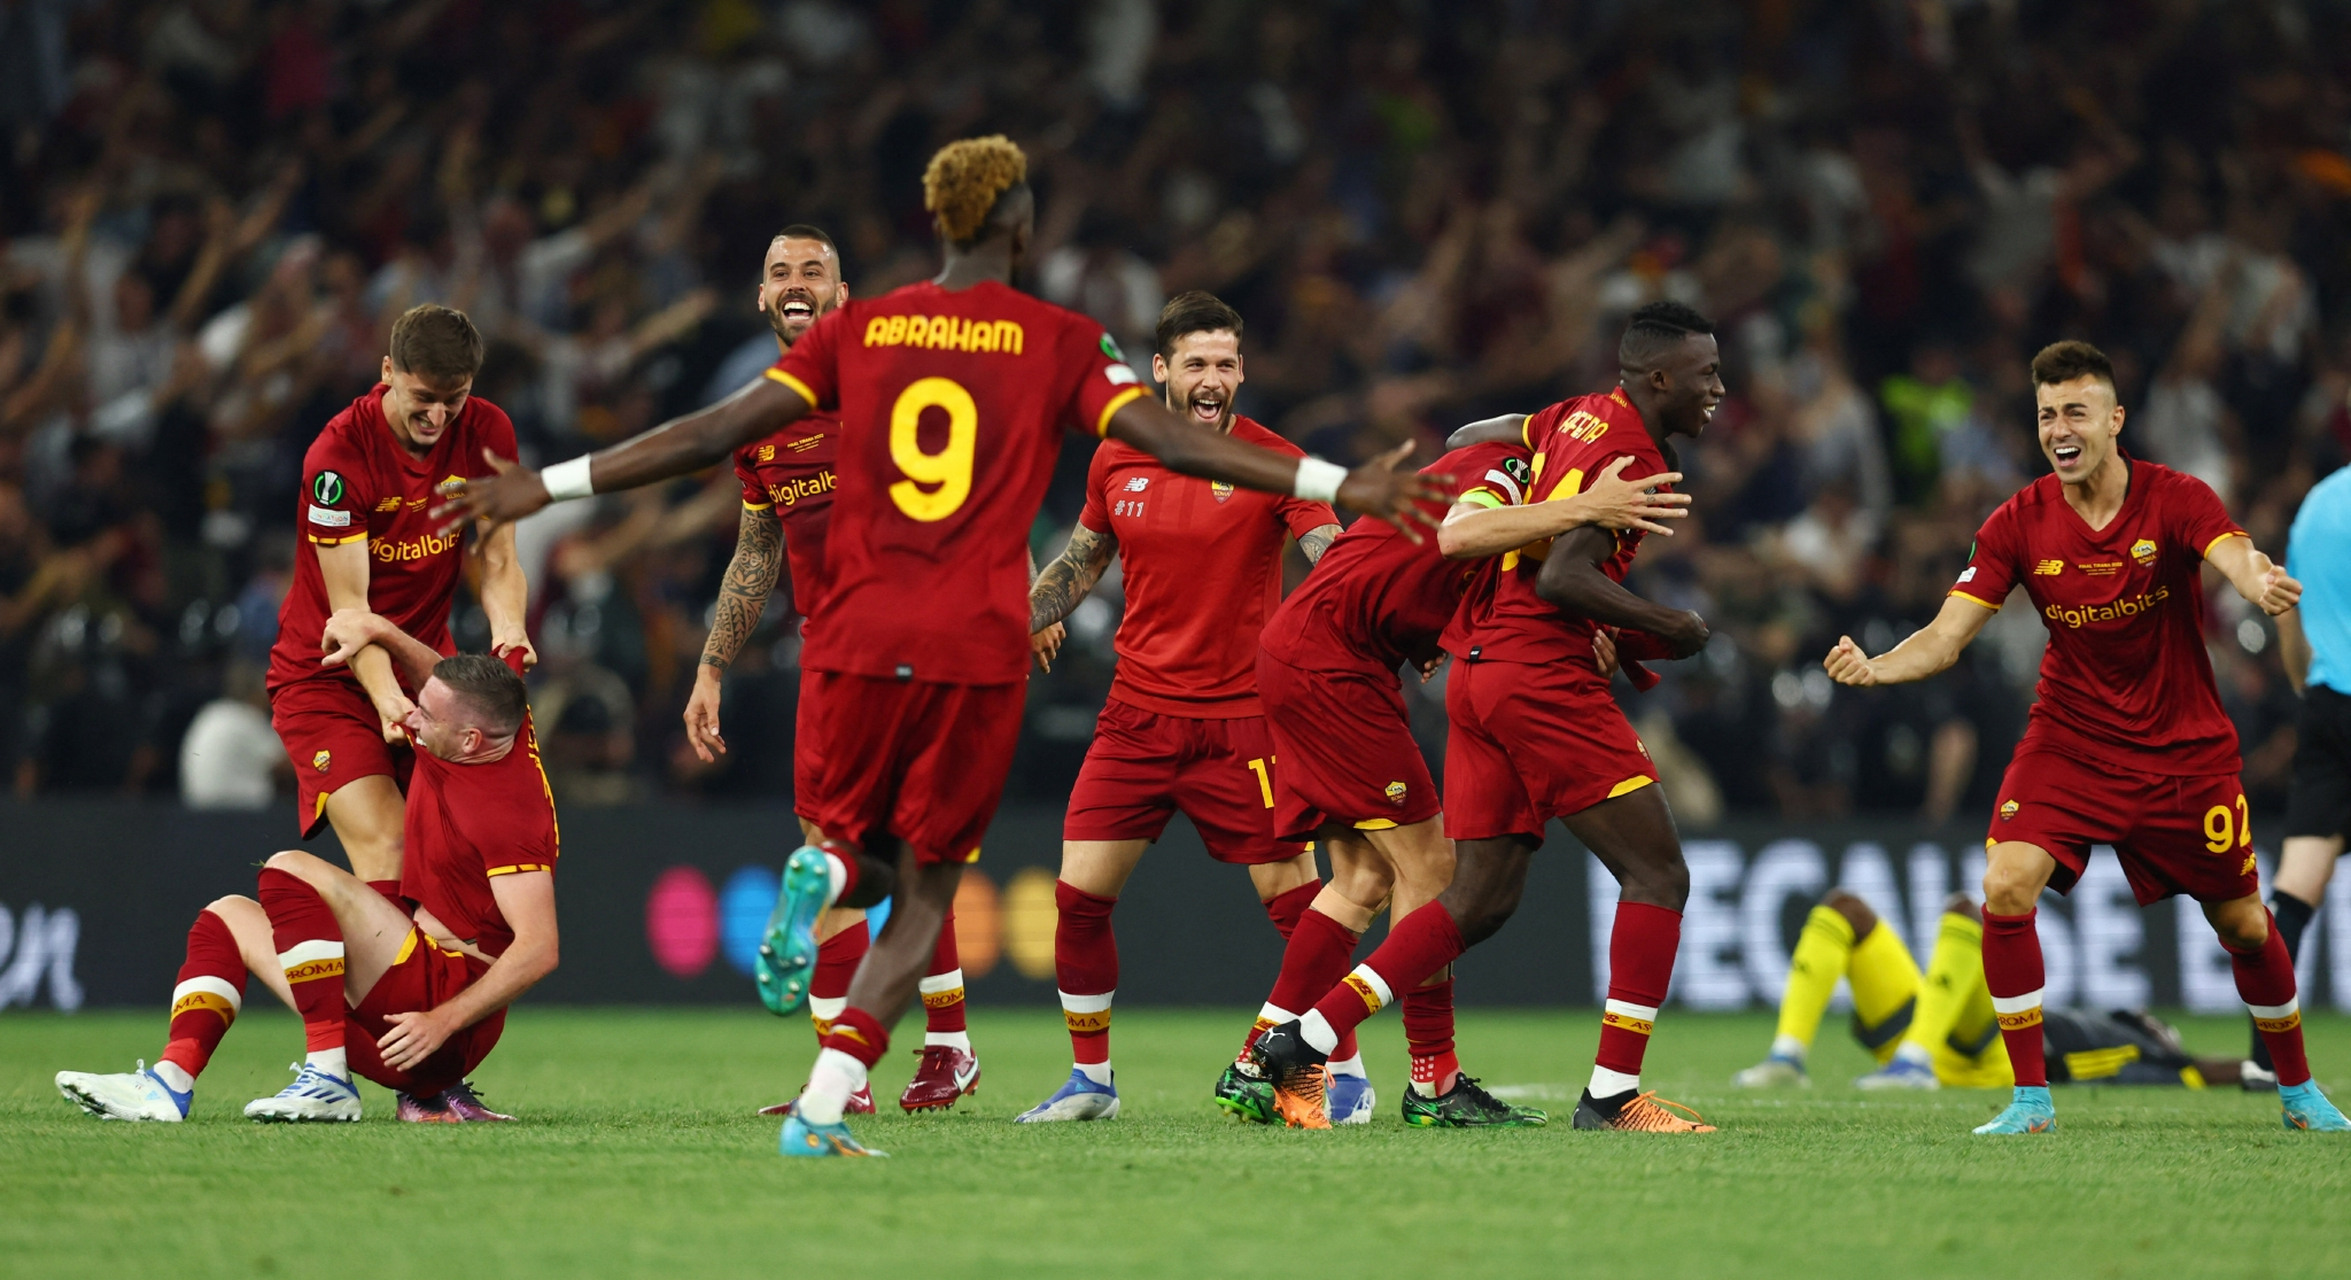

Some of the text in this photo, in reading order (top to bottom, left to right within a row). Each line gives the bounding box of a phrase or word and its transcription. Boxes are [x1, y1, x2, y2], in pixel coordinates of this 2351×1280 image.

[863, 315, 1024, 355] ABRAHAM
[889, 376, 978, 522] 9
[769, 470, 838, 506] digitalb
[1115, 500, 1145, 517] #11
[2045, 585, 2170, 629] digitalbits
[1248, 754, 1276, 809] 1
[2204, 793, 2252, 853] 92
[289, 961, 344, 979] ROMA
[931, 990, 963, 1005] ROM
[1999, 1008, 2043, 1026] ROMA
[2260, 1014, 2298, 1030] ROM
